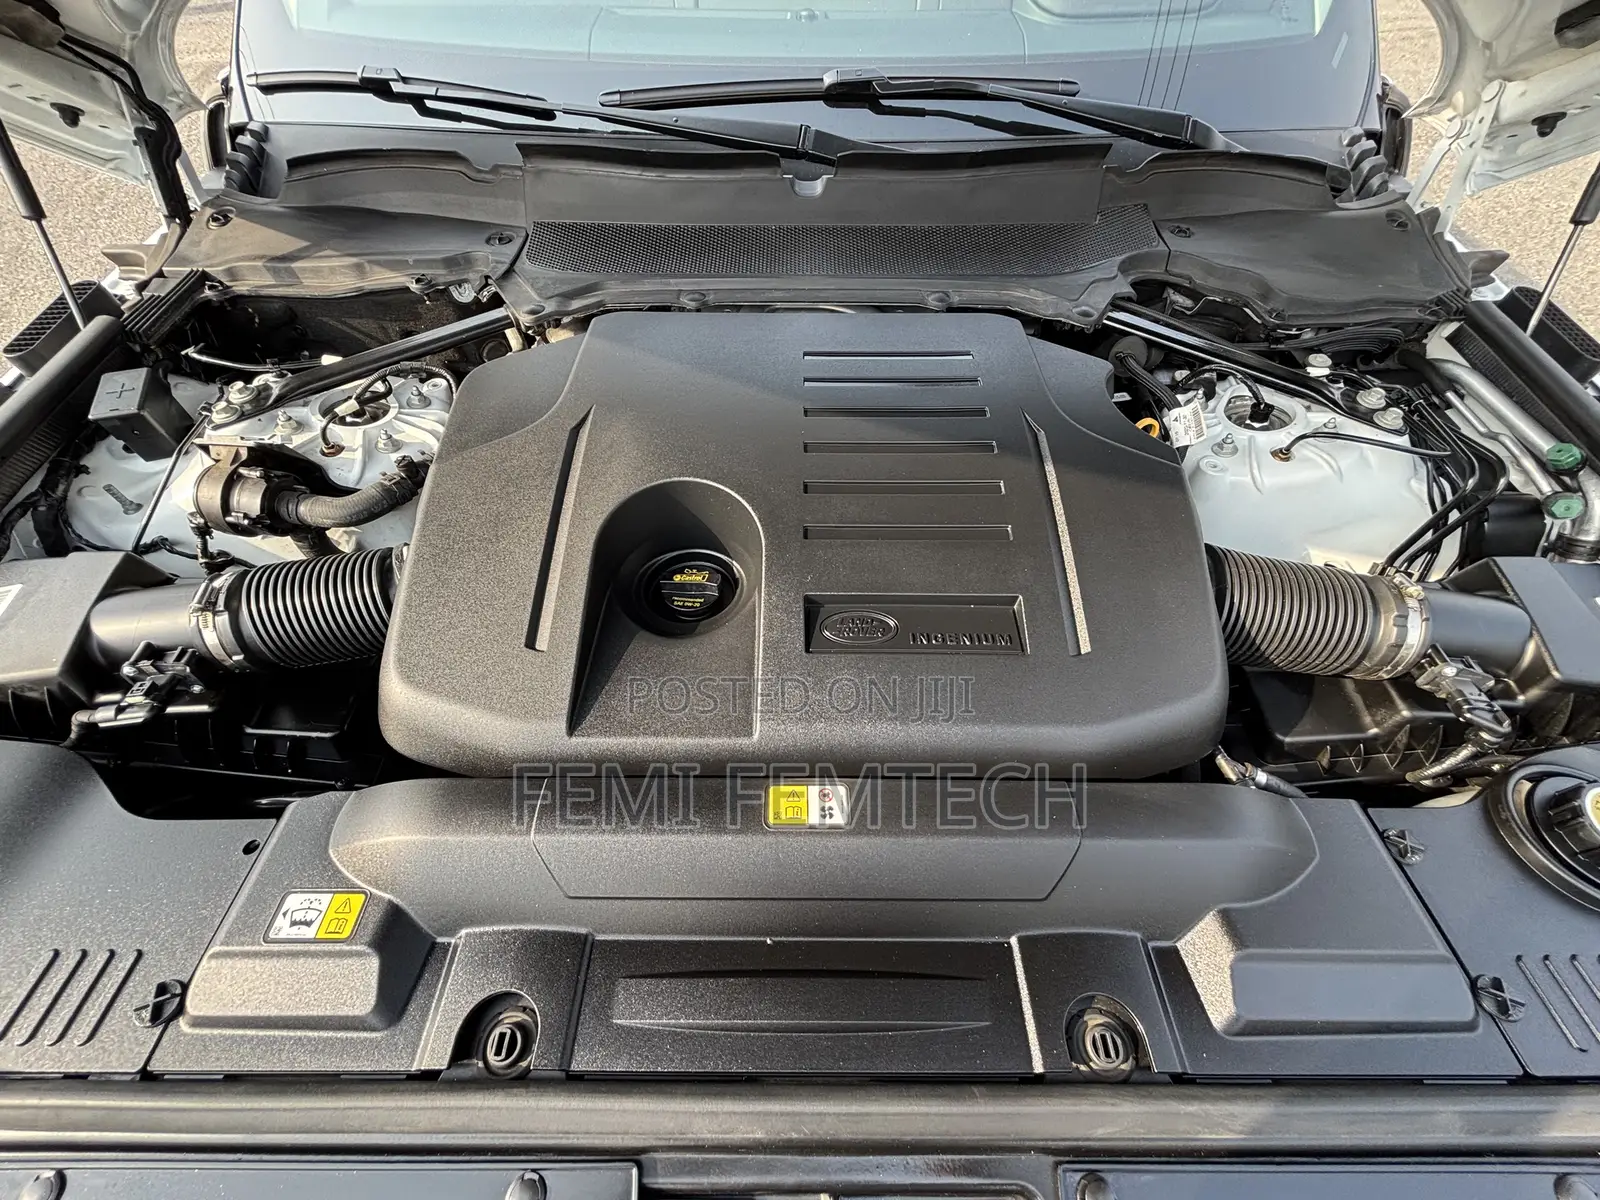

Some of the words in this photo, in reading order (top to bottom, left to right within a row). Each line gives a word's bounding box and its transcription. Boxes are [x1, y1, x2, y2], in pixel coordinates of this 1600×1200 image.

[680, 574, 702, 582] Castrol
[839, 627, 885, 637] ROVER
[909, 632, 1013, 646] INGENIUM
